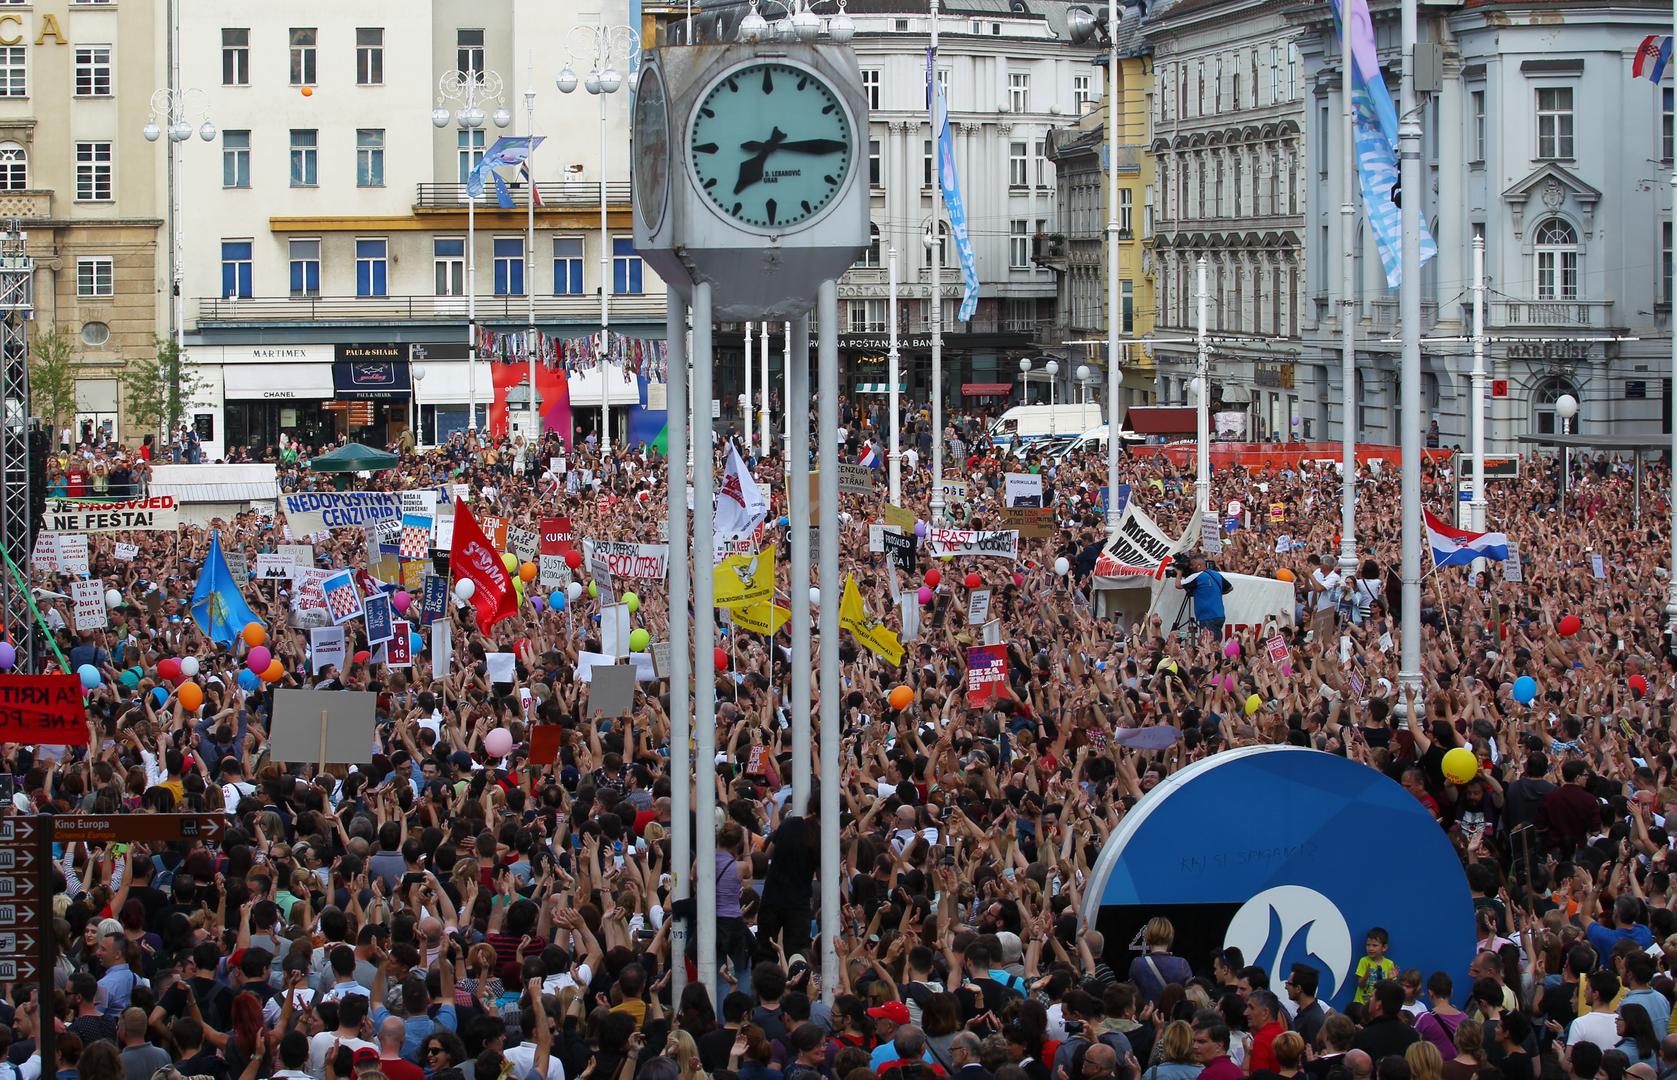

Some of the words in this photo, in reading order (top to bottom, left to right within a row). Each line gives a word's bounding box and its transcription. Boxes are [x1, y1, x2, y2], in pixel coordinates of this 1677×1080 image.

[838, 285, 914, 298] POŠTAKA
[850, 338, 909, 348] POŠTANKA
[913, 339, 945, 347] BANA
[252, 349, 306, 358] MARTIMEX
[371, 348, 399, 356] SHARK
[54, 516, 78, 530] NE
[86, 510, 153, 529] FEŠTA!
[931, 529, 974, 543] HRAST
[943, 541, 960, 552] NE
[425, 577, 433, 612] ZNANJE
[430, 600, 437, 612] JE
[398, 636, 404, 646] 6
[394, 649, 405, 659] 16
[55, 818, 74, 829] Kino
[77, 819, 110, 831] Europa
